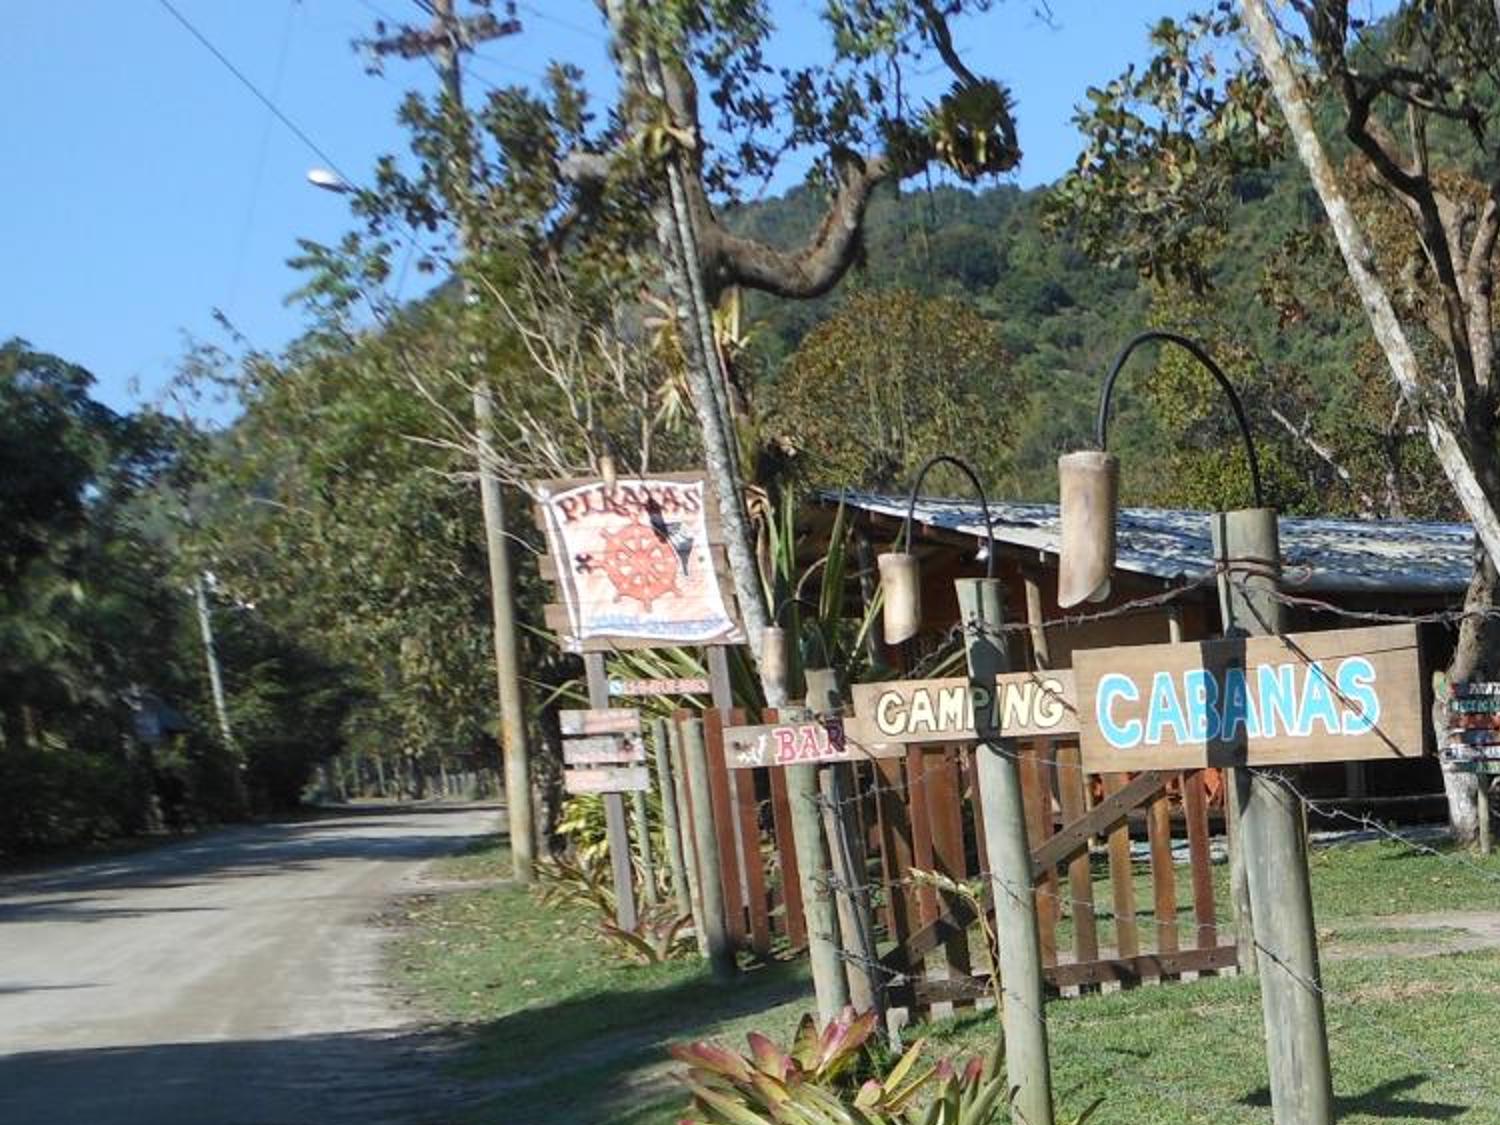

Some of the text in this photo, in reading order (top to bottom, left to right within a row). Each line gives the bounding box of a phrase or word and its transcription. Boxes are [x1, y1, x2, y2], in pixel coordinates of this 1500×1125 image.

[556, 484, 701, 521] PIRATAS
[875, 680, 1066, 736] CAMPING
[1096, 656, 1380, 748] CABANAS
[771, 720, 848, 764] BAR
